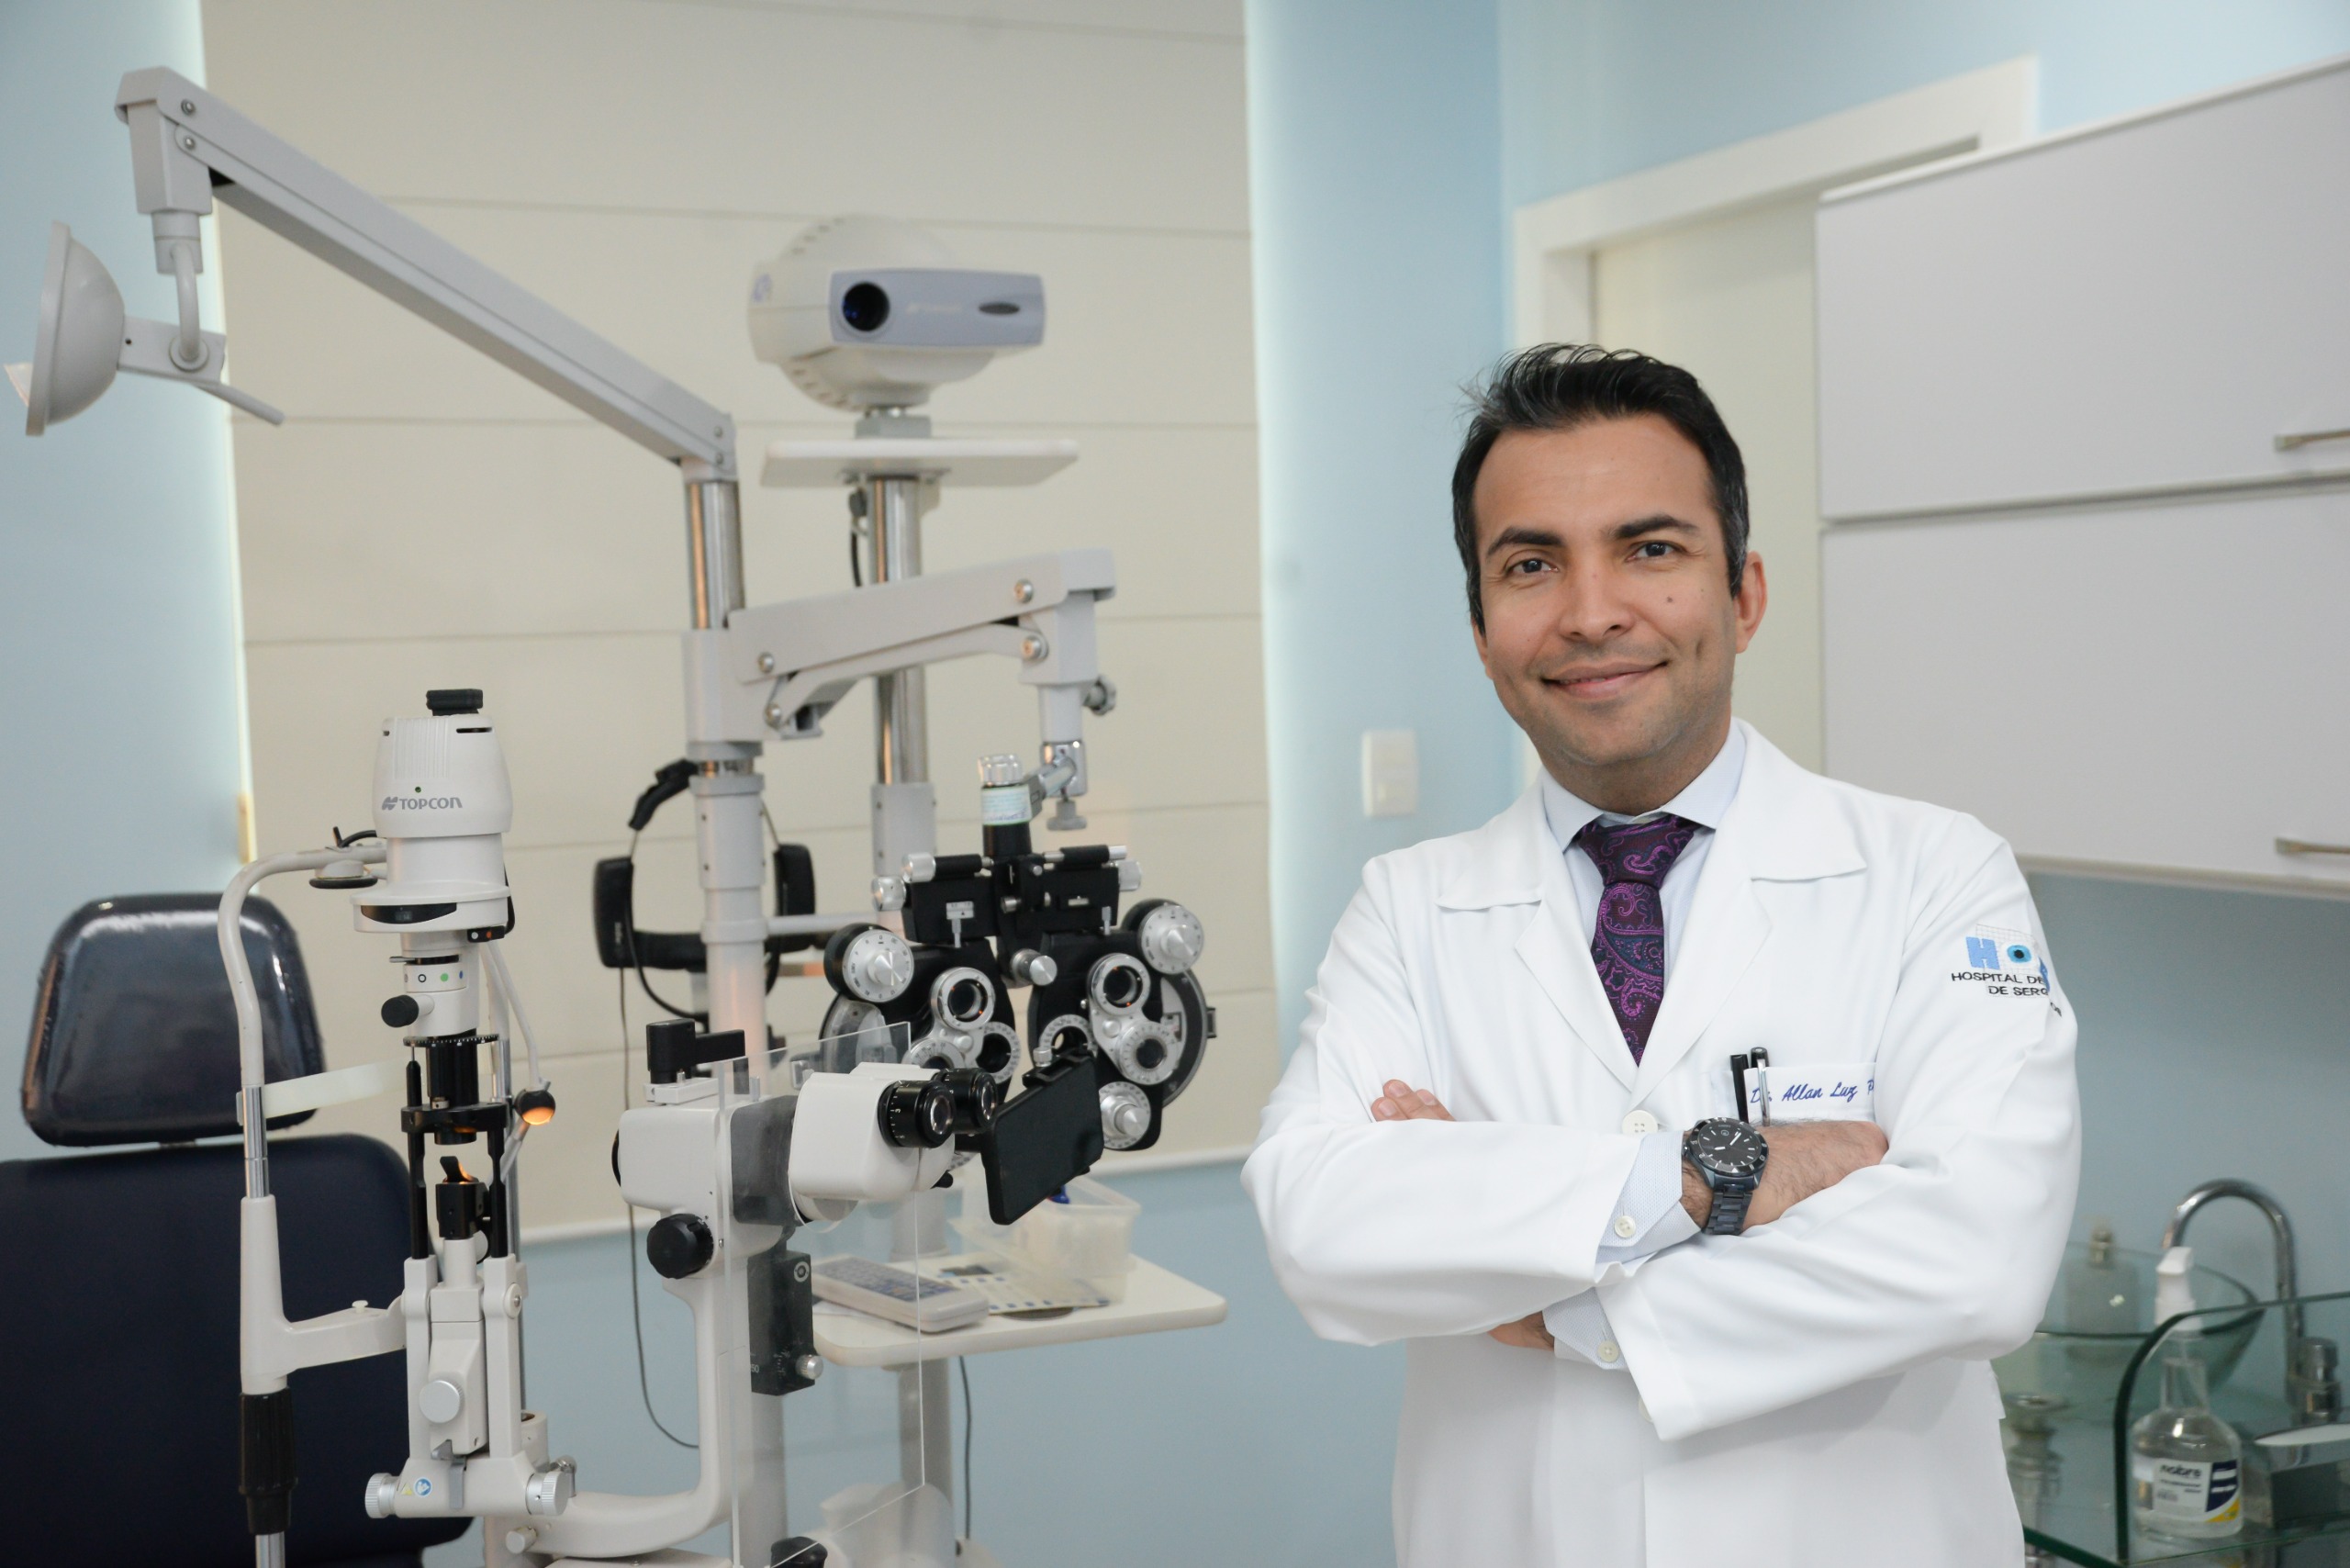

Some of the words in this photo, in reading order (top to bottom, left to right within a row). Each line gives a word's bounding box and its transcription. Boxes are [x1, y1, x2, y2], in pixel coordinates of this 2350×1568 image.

[398, 797, 463, 810] TOPCON
[1951, 971, 2023, 984] HOSPITAL
[1987, 985, 2009, 995] DE
[1781, 1083, 1823, 1102] Allan
[1830, 1081, 1858, 1103] Luz
